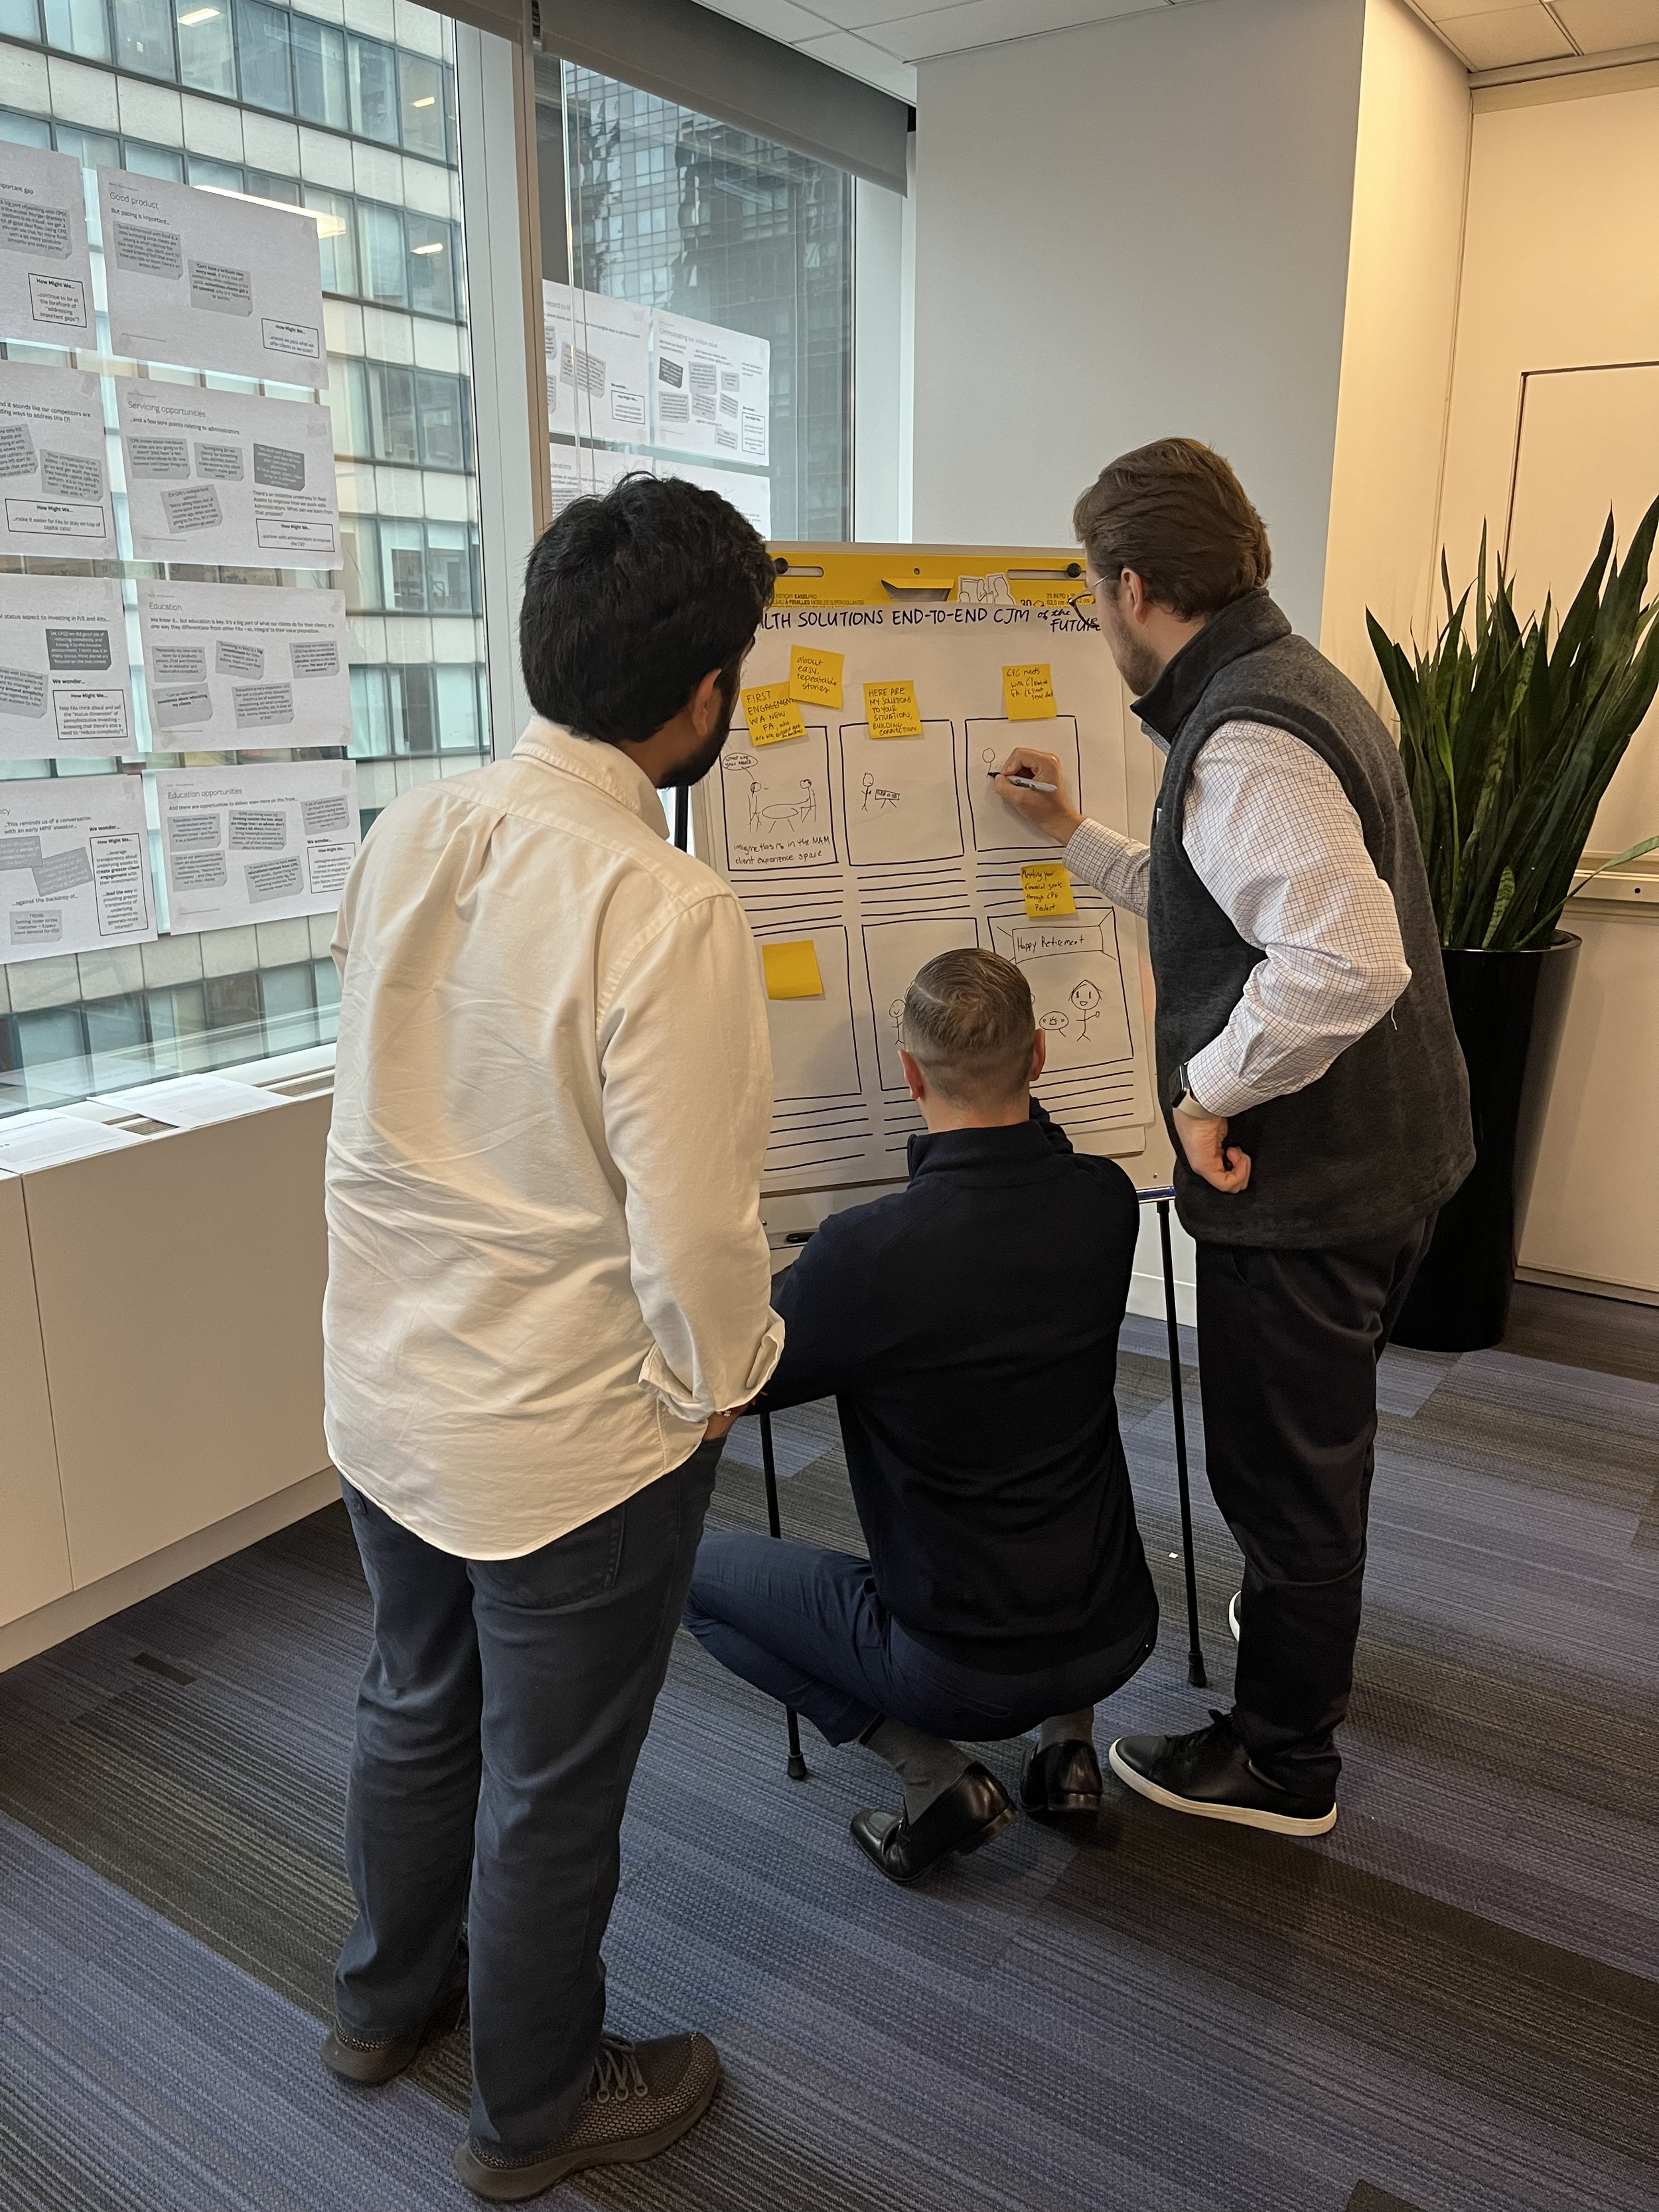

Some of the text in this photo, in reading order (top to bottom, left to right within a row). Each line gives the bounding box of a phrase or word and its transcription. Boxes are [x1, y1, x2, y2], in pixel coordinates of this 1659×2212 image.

[109, 192, 159, 209] Good product
[121, 210, 137, 219] pacing
[48, 300, 70, 309] forefront
[51, 407, 82, 417] competitors
[128, 400, 206, 418] Servicing opportunities
[149, 602, 182, 611] Education
[762, 613, 791, 630] LTH
[798, 609, 883, 627] SOLUTIONS
[892, 608, 987, 625] END-TO-END
[993, 609, 1030, 625] CJM
[1037, 610, 1049, 620] of
[796, 655, 823, 666] about
[798, 665, 819, 674] easy,
[797, 674, 837, 686] repeatable
[747, 691, 770, 703] FIRST
[869, 688, 887, 697] HERE
[882, 696, 911, 705] SOLUTIONS
[881, 705, 897, 713] YOUR
[769, 711, 785, 720] NEW
[201, 788, 243, 798] opportunities
[734, 844, 760, 855] imagine
[760, 843, 774, 851] this
[812, 836, 831, 845] MAM
[735, 850, 822, 865] client experience space
[1022, 869, 1054, 882] Meeting your
[1017, 934, 1085, 953] Happy Retirement
